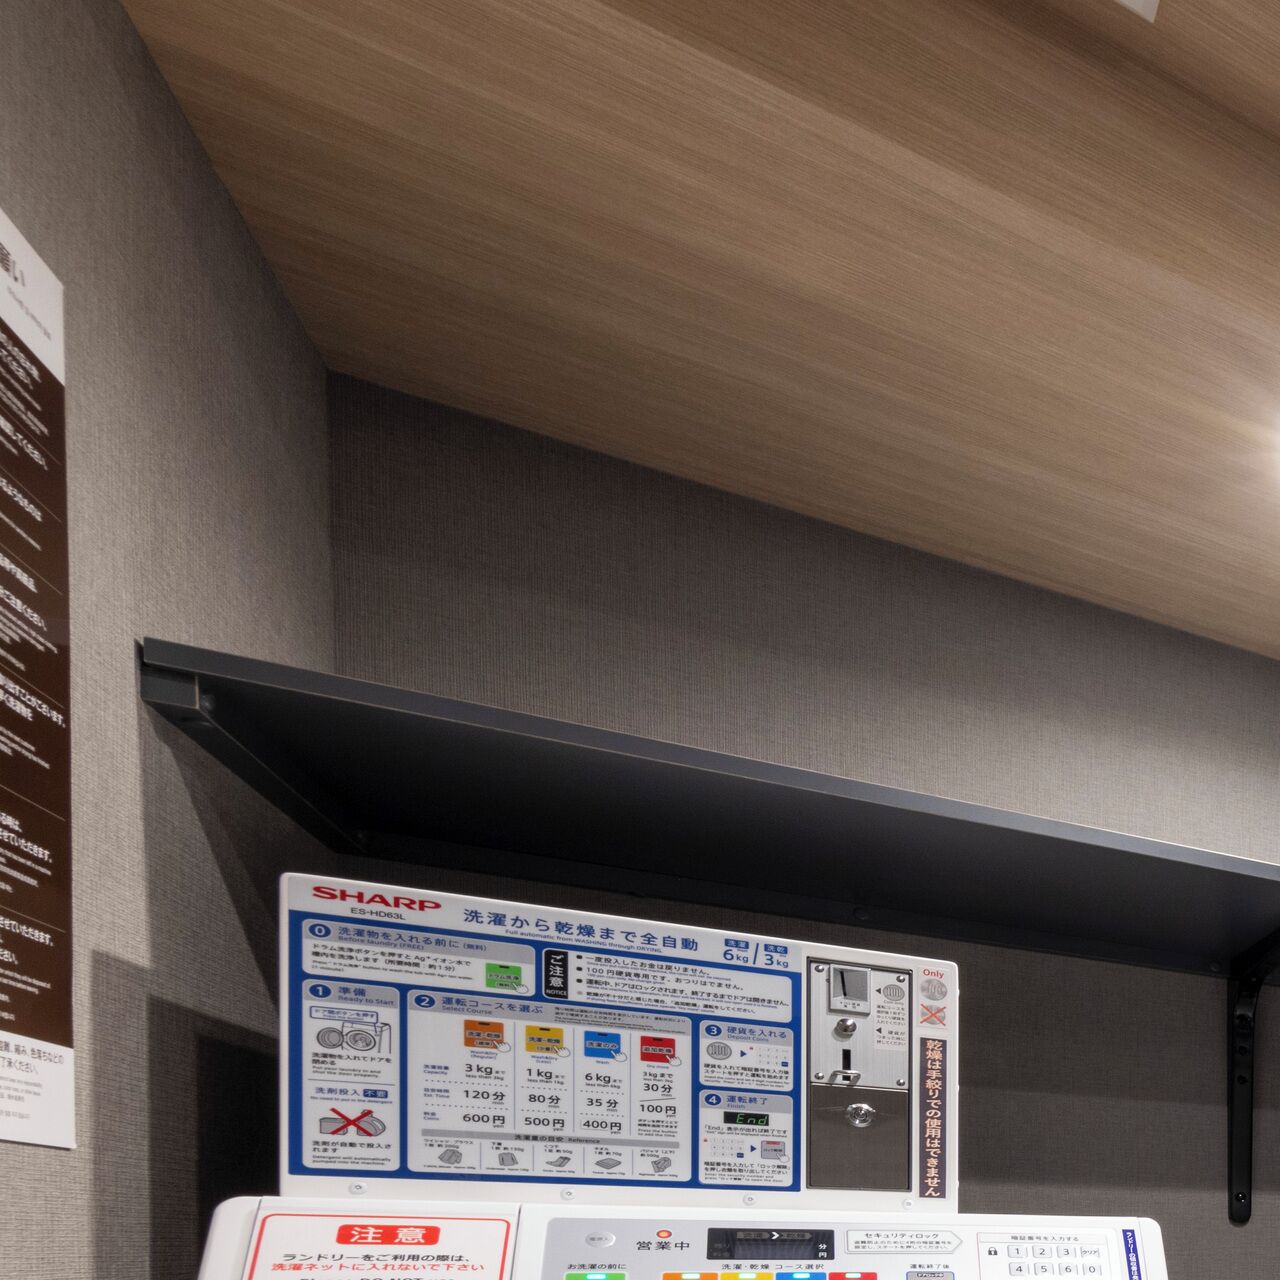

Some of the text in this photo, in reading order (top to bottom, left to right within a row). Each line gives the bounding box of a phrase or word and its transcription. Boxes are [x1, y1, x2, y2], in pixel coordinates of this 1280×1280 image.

[312, 886, 442, 911] SHARP
[350, 907, 406, 920] ES-HD63L
[463, 908, 699, 952] 洗濯から乾燥まで全自動
[338, 926, 459, 949] 洗濯物を入れる前に
[520, 931, 554, 940] automatic
[575, 938, 607, 947] WASHING
[549, 955, 564, 988] ご注意
[923, 969, 944, 979] Only
[338, 986, 366, 997] 準備
[441, 1005, 492, 1016] Select Course
[442, 996, 544, 1015] 運転コースを選ぶ
[727, 1026, 786, 1039] 硬貨を入れる
[315, 1087, 388, 1099] 洗剤投入 不要
[727, 1095, 768, 1105] 運転終了
[737, 1114, 768, 1125] End
[925, 1040, 943, 1197] 乾燥は手絞りでの使用はできません
[350, 1226, 426, 1244] 注意
[1011, 1234, 1079, 1243] 暗証番号を入力する
[636, 1241, 690, 1251] 営業中
[282, 1253, 470, 1262] ランドリーをご利用の際は、
[271, 1262, 484, 1272] 洗濯ネットに入れないで下さい
[567, 1263, 627, 1271] お洗濯の前に
